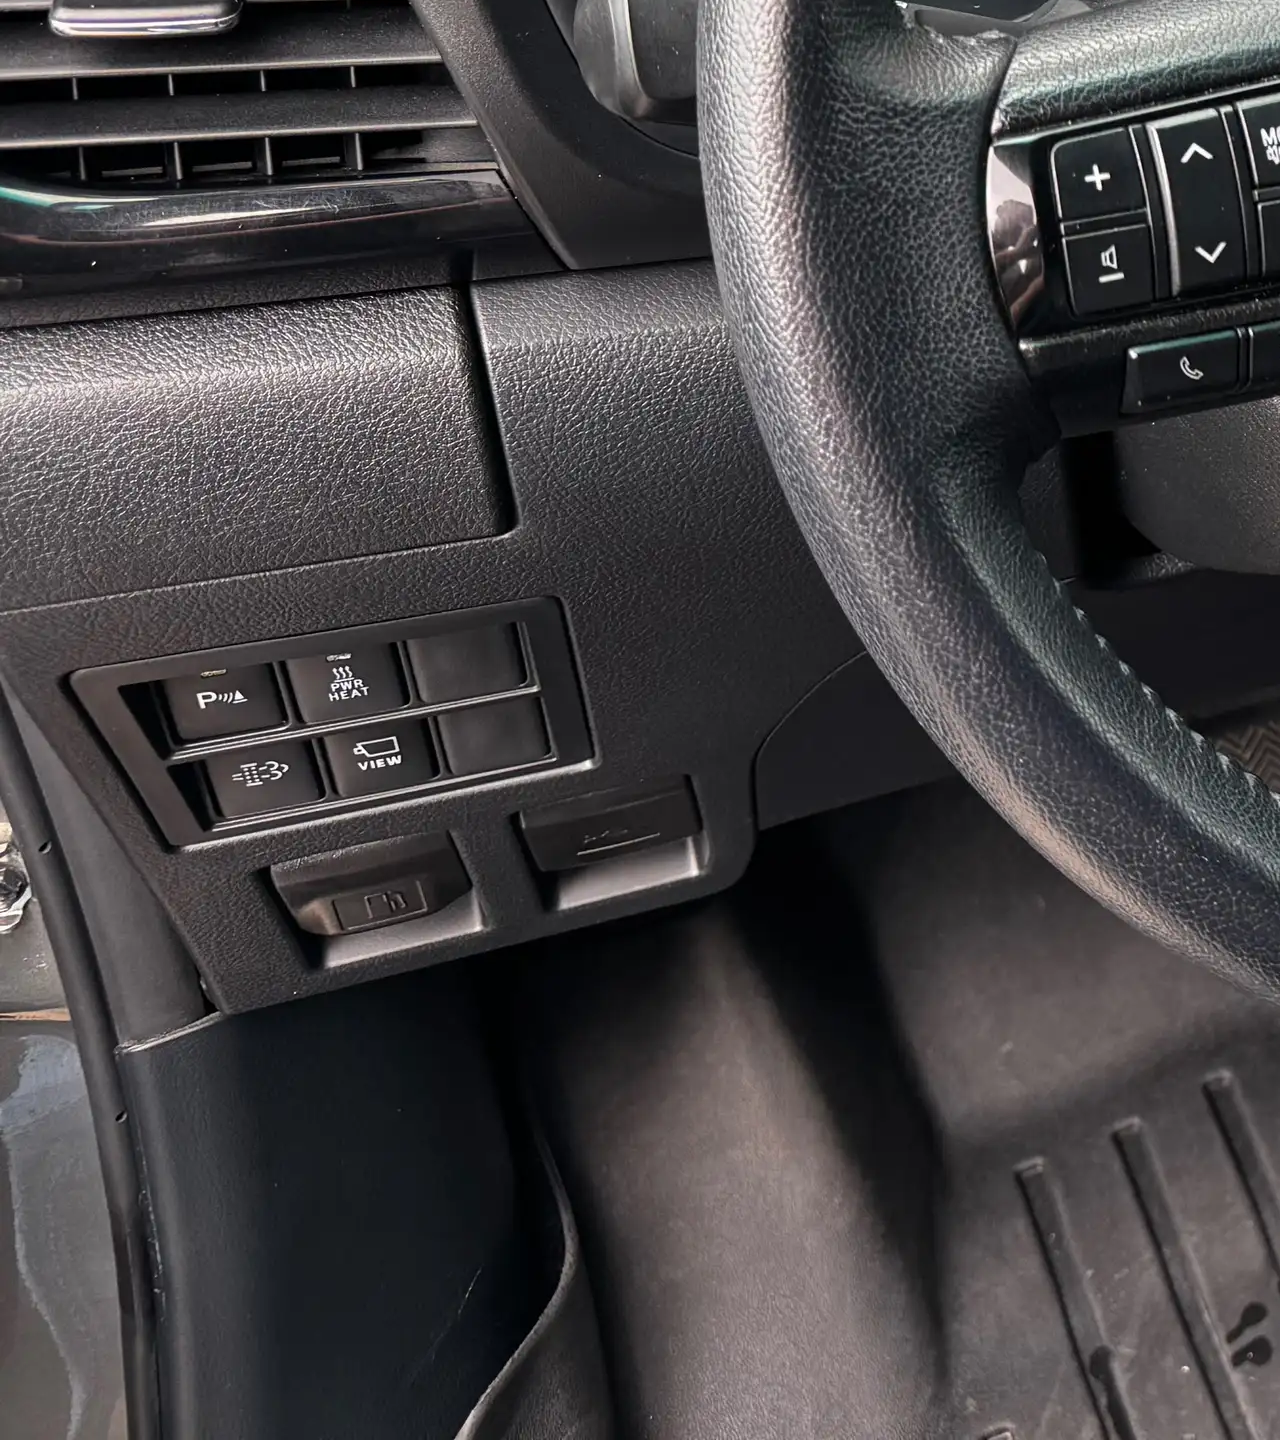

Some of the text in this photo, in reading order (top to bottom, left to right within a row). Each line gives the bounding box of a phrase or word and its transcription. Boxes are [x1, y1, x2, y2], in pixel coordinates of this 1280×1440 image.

[328, 686, 369, 702] HEAT
[330, 677, 364, 695] PWR
[357, 754, 403, 771] VIEW
